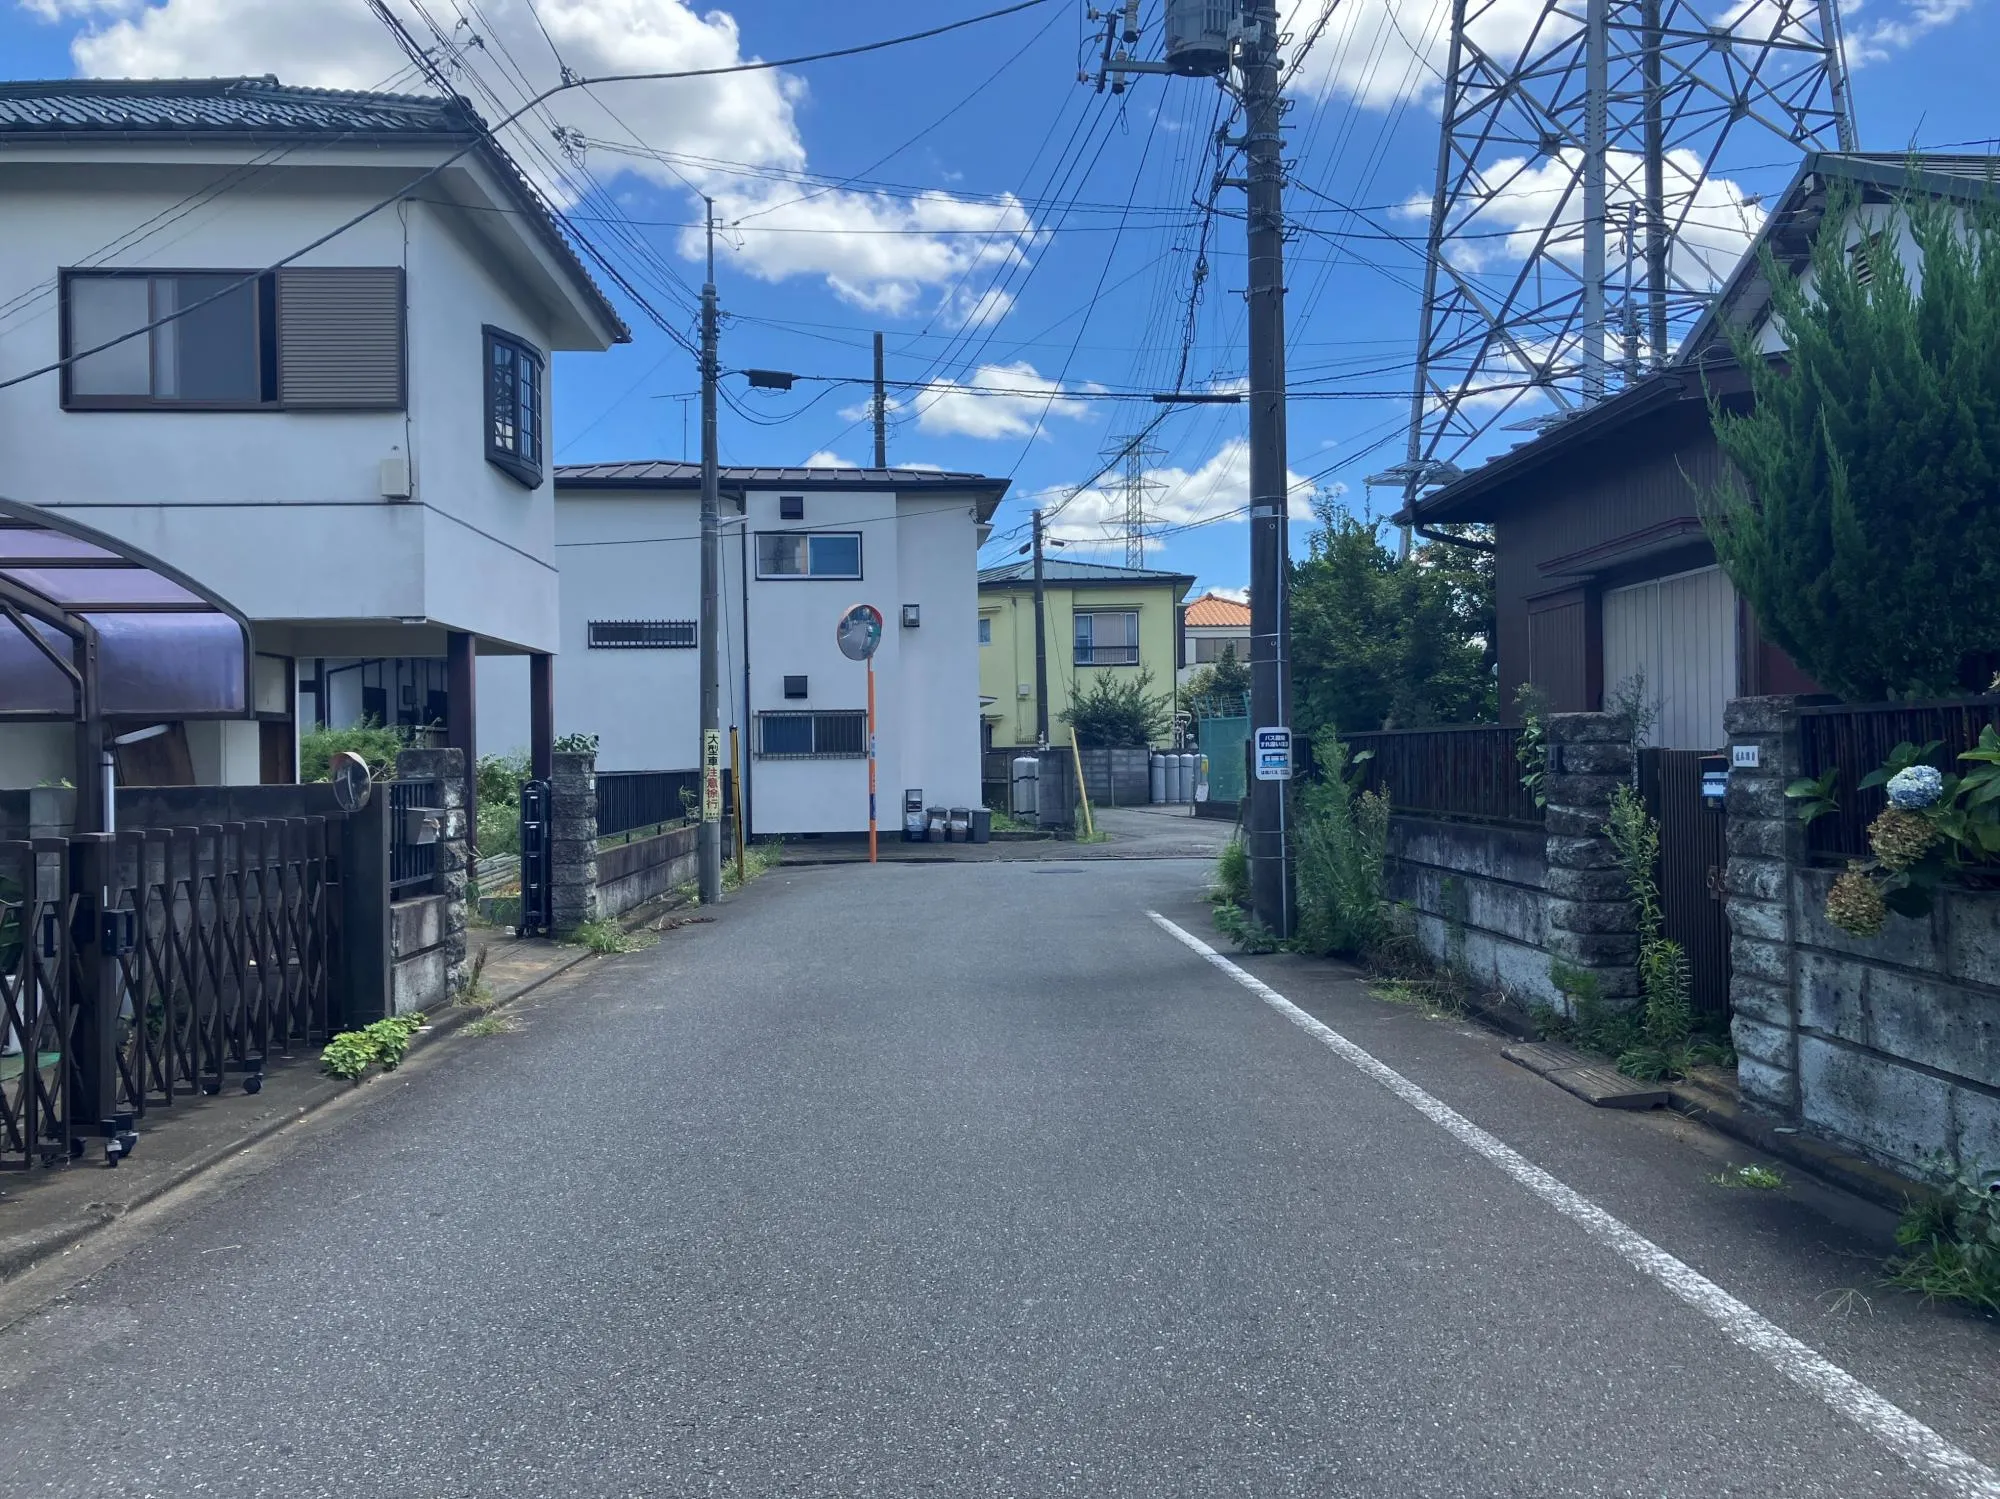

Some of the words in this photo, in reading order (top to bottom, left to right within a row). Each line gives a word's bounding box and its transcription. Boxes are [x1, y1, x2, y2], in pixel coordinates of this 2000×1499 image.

[705, 734, 719, 809] 大型車注意徐行
